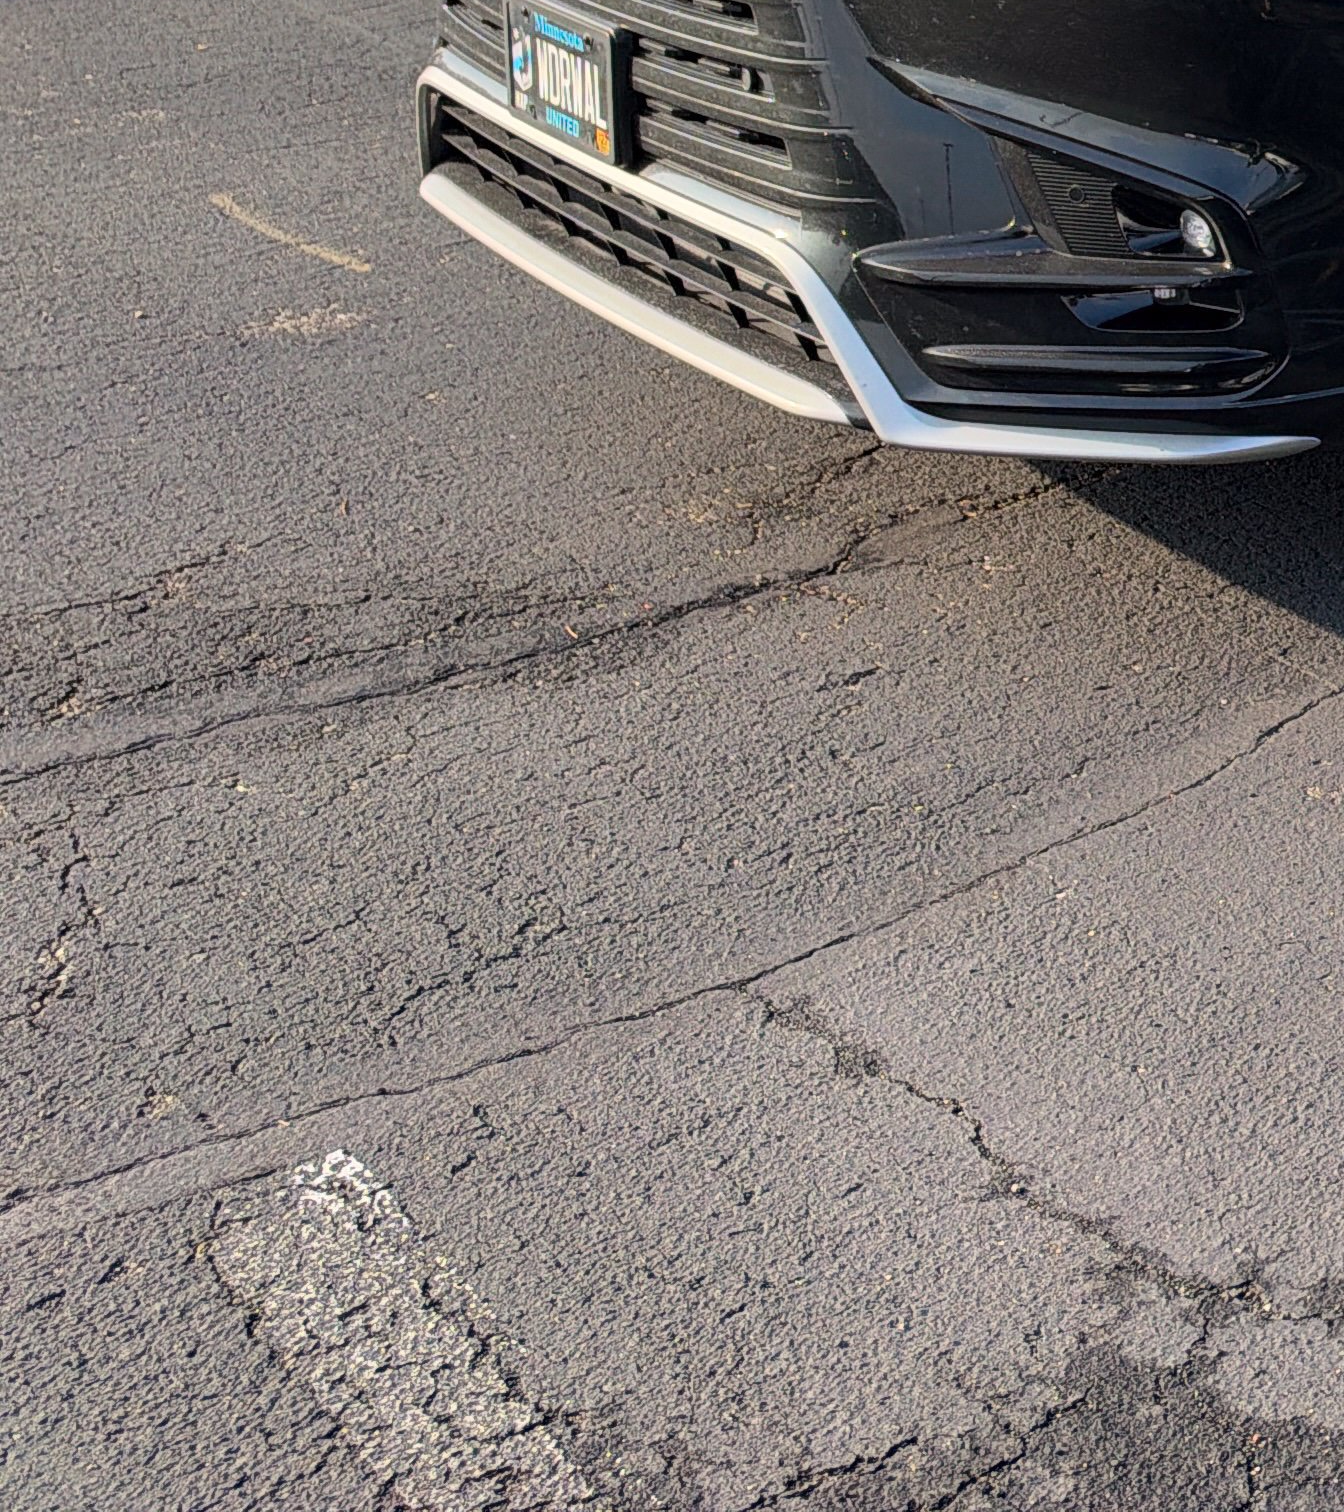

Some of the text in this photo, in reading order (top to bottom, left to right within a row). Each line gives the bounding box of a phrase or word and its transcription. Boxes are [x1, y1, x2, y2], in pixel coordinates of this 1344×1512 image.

[533, 11, 585, 53] Minnesota
[536, 37, 607, 130] WDRWAL
[546, 105, 580, 138] UNITED
